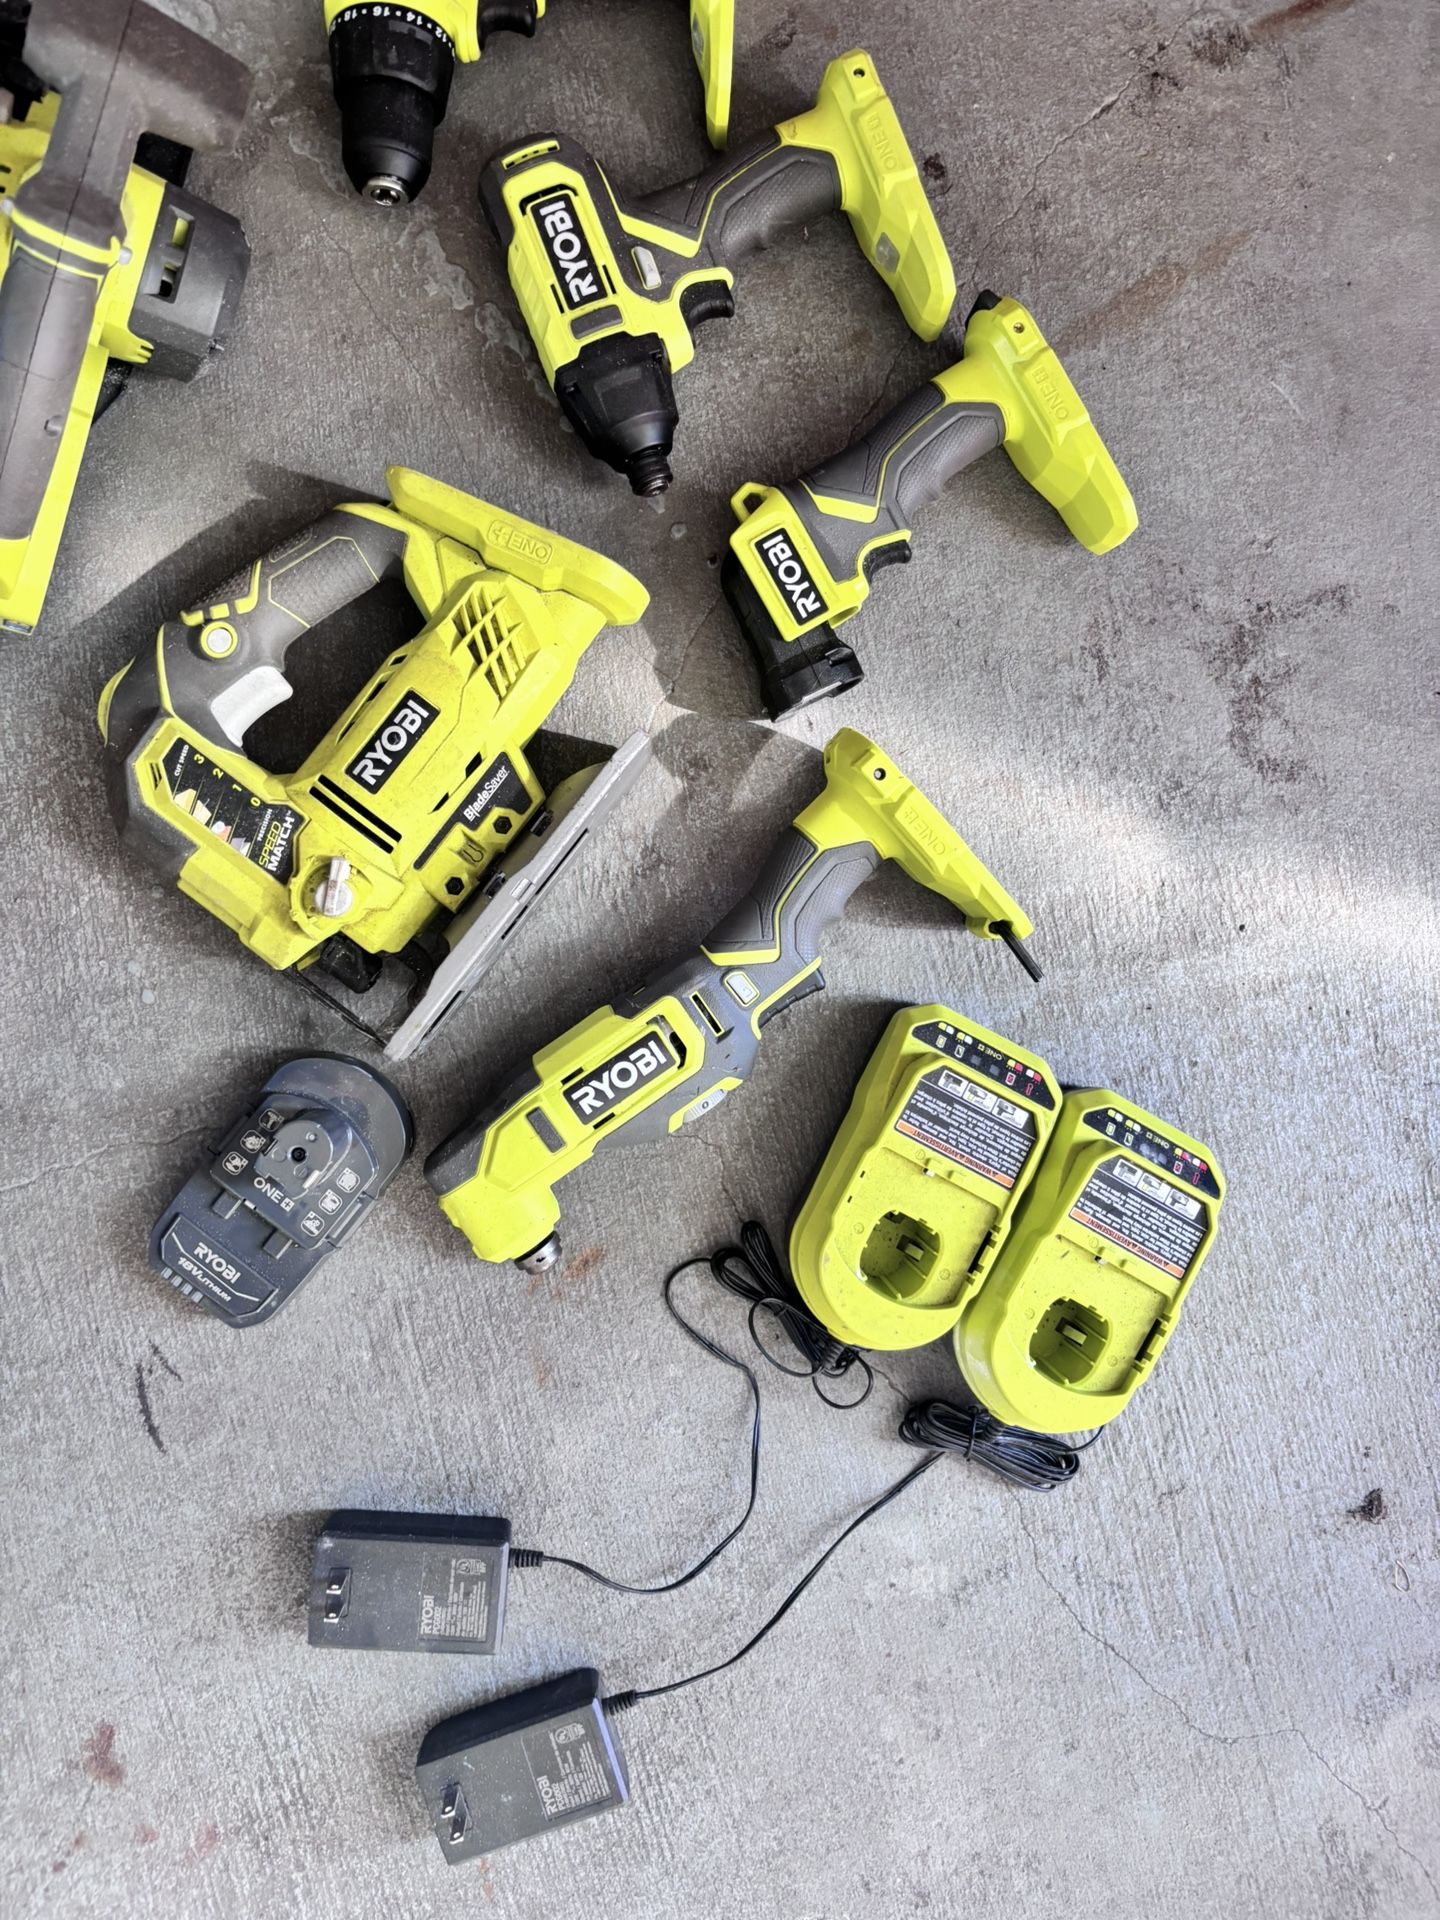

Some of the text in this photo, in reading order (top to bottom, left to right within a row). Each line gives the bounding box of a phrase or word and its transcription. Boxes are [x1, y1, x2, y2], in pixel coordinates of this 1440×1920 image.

[344, 9, 357, 21] 18
[372, 6, 390, 17] 16
[406, 11, 423, 25] 14
[539, 200, 598, 302] RYOBI
[762, 534, 821, 619] RYOBI
[174, 744, 189, 776] CUT SPEED
[194, 754, 205, 764] 3
[352, 699, 429, 786] RYOBI
[213, 768, 224, 779] 2
[232, 784, 242, 792] 1
[250, 797, 261, 807] 0
[257, 809, 272, 841] PRECISION
[259, 821, 281, 868] SPEED
[571, 1040, 667, 1115] RYOBI
[912, 1129, 992, 1175] WARNING AVERTISSEMENT
[1085, 1217, 1163, 1265] WARNING AVERTISSEMENT
[193, 1241, 242, 1284] RYOBI
[420, 1594, 435, 1635] RYOBI
[536, 1775, 558, 1815] RYOBI
